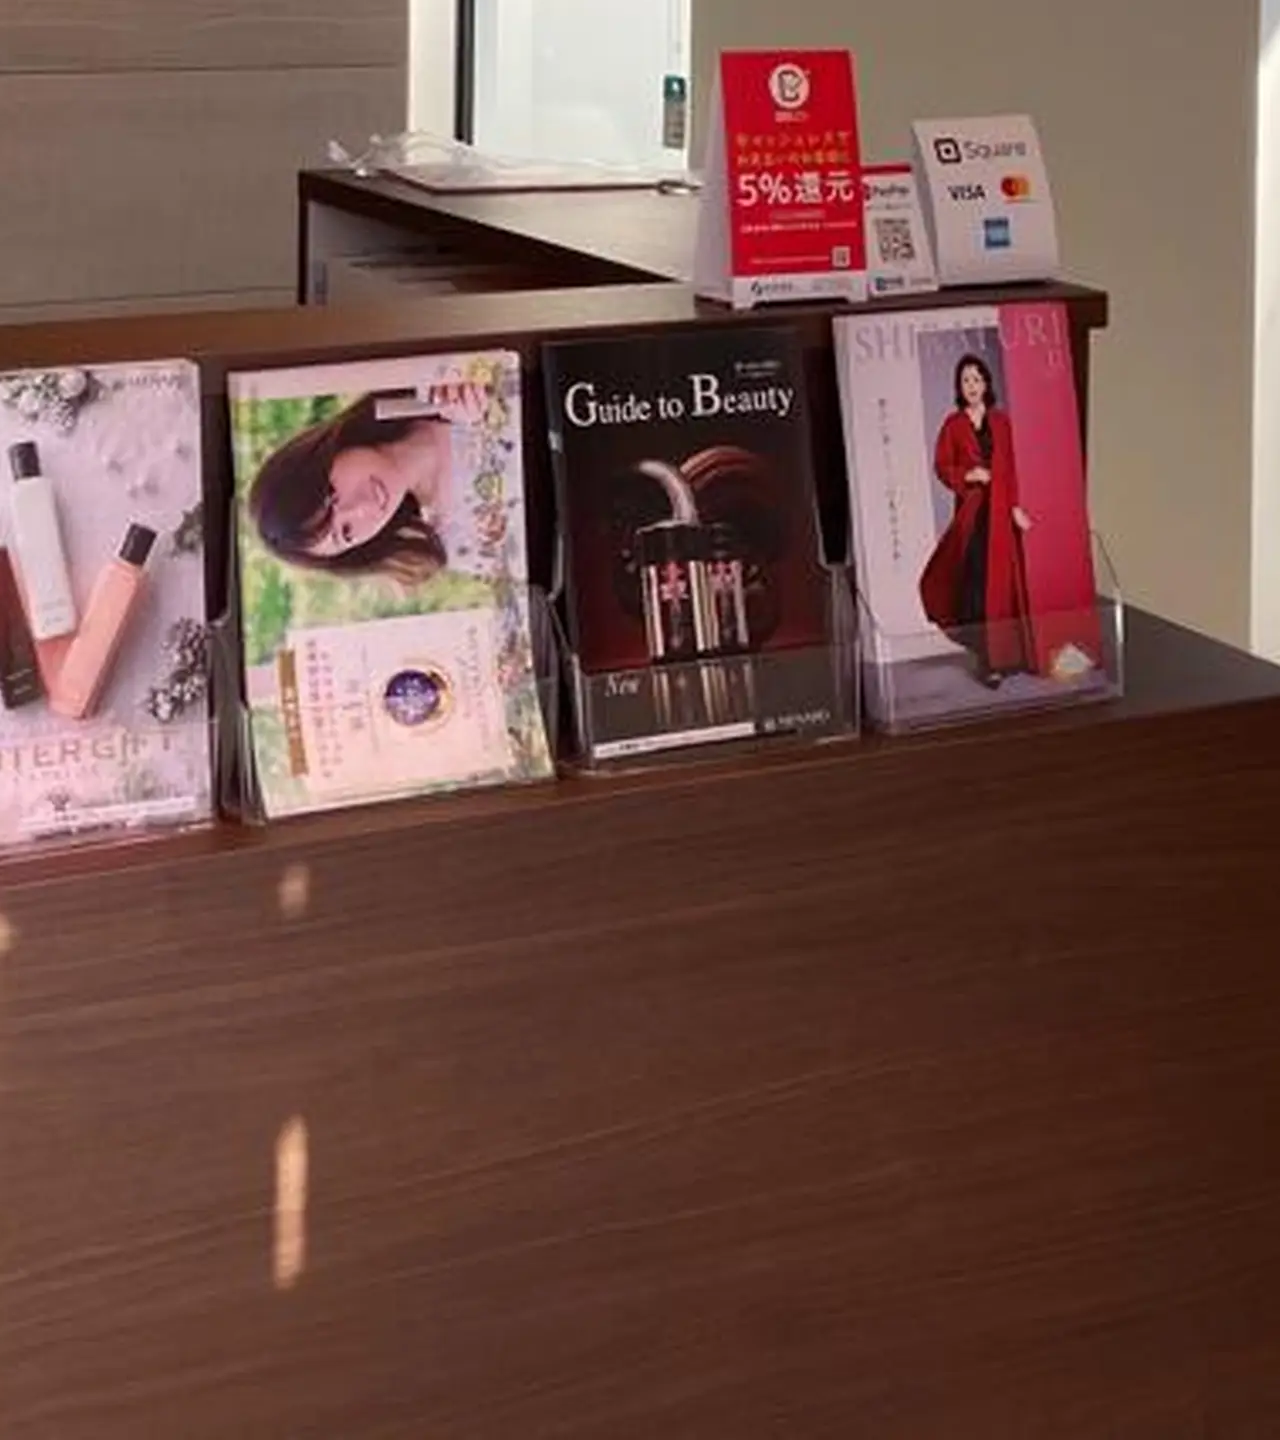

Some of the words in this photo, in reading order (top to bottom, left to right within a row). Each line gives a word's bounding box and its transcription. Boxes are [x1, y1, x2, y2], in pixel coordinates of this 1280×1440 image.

[948, 184, 986, 201] VISA
[564, 381, 652, 428] Guide
[657, 396, 685, 419] to
[688, 373, 794, 417] Beauty
